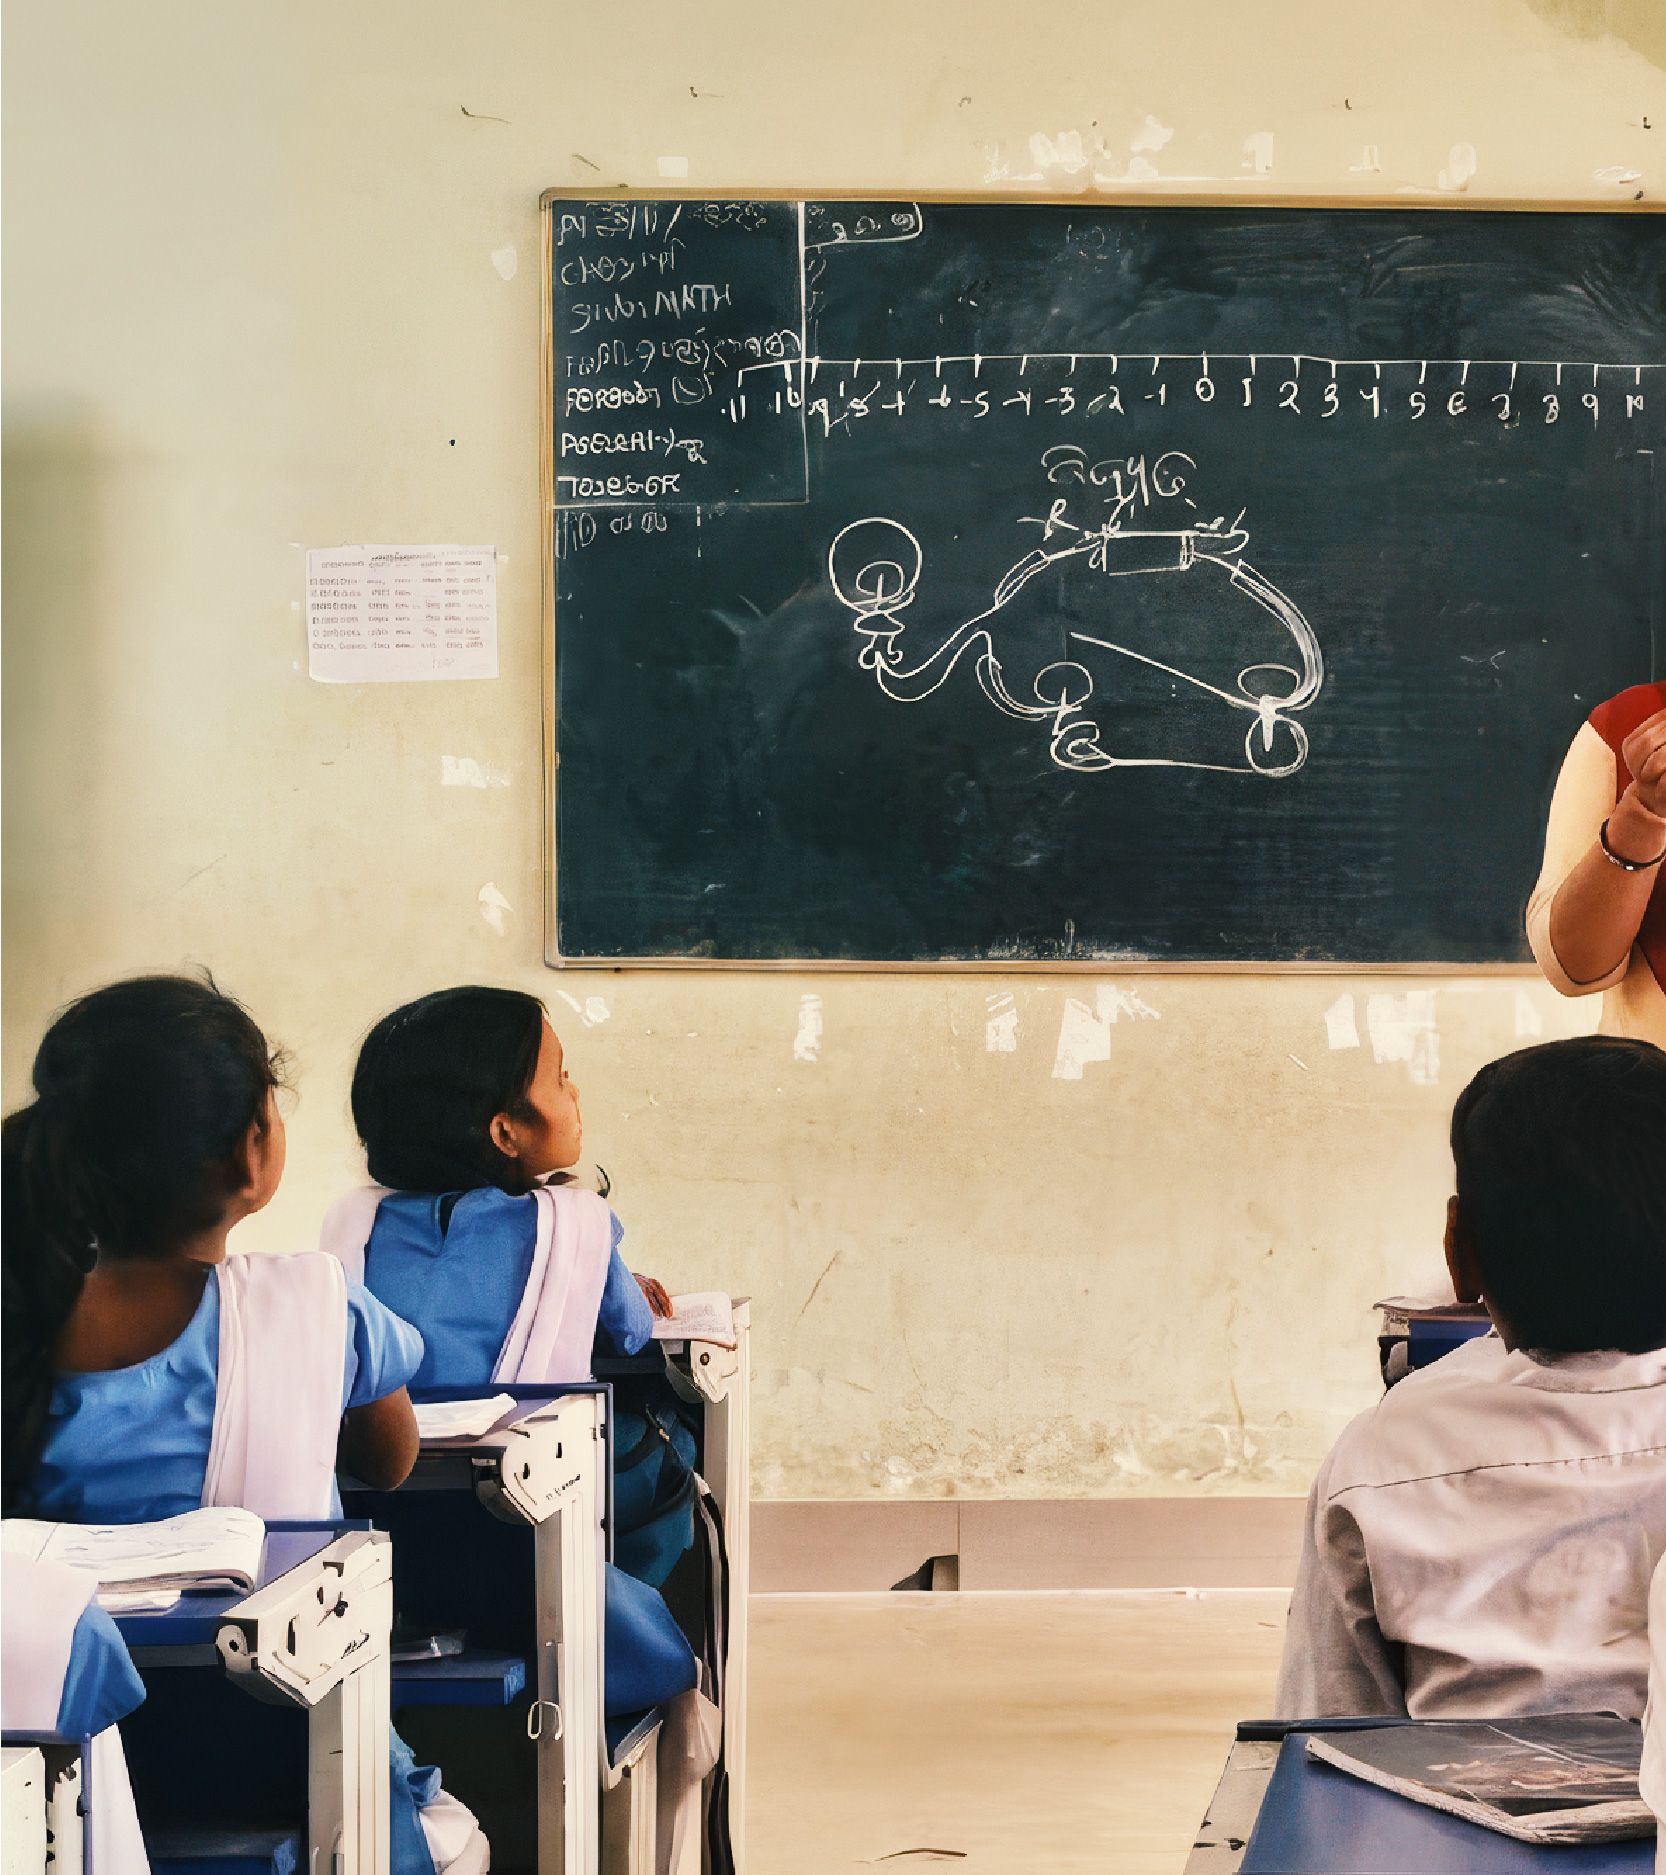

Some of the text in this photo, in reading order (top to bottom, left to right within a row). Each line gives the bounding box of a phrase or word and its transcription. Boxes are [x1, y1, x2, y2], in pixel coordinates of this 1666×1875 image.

[1195, 377, 1215, 402] 0
[1278, 380, 1301, 414] 2
[1320, 381, 1340, 418] 3
